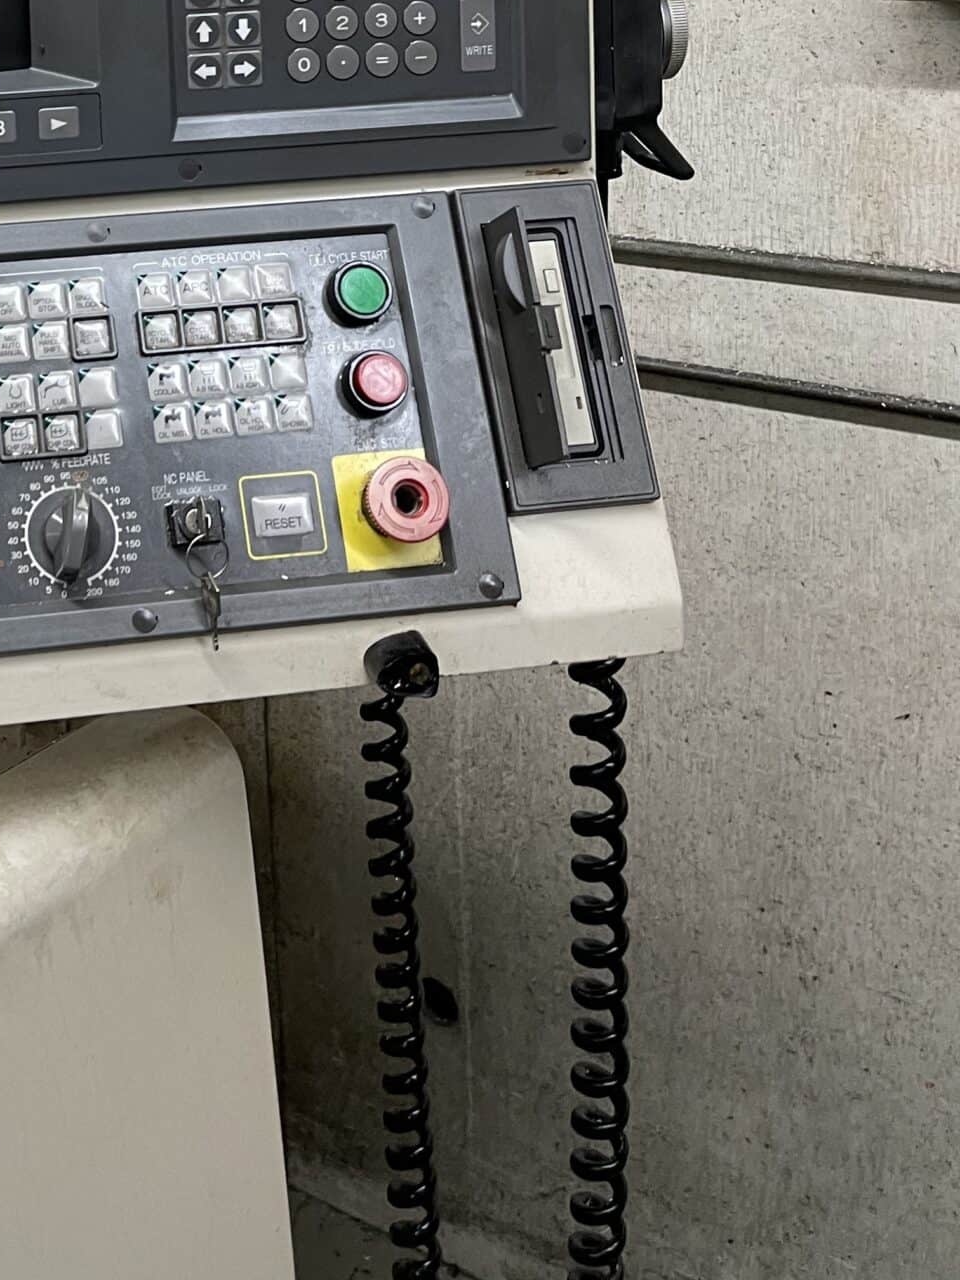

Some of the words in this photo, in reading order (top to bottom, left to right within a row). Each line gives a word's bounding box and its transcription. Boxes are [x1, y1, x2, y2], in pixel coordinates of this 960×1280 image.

[298, 17, 307, 32] 1
[336, 15, 349, 31] 2
[375, 12, 388, 28] 3
[465, 44, 493, 56] WRITE
[297, 57, 311, 72] 0
[160, 255, 188, 268] ATC
[191, 250, 262, 266] OPERATION
[360, 249, 390, 261] START
[62, 453, 111, 468] FEEDRATE
[164, 473, 177, 484] NC
[180, 470, 210, 483] PANEL
[105, 486, 120, 494] 110
[20, 494, 30, 502] 70
[115, 497, 131, 505] 120
[121, 511, 137, 519] 130
[265, 515, 302, 530] RESET
[8, 536, 18, 545] 40
[18, 565, 29, 573] 20
[115, 566, 131, 574] 170
[28, 578, 39, 586] 10
